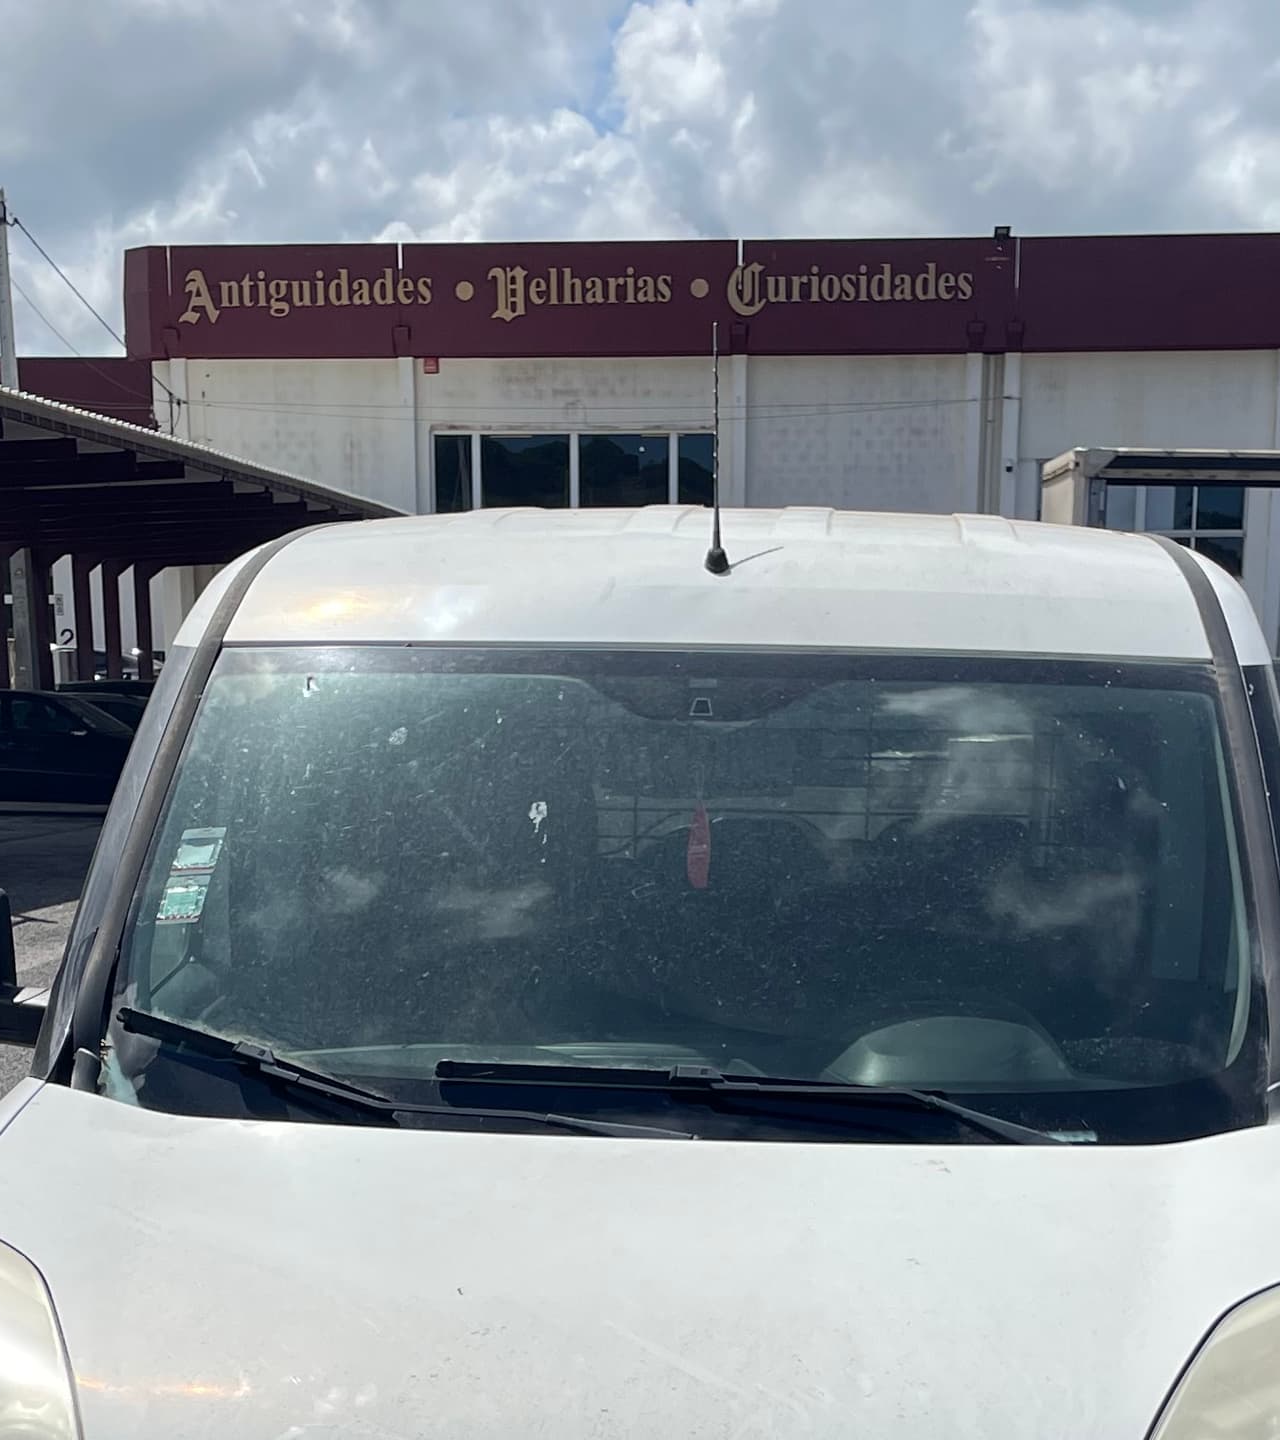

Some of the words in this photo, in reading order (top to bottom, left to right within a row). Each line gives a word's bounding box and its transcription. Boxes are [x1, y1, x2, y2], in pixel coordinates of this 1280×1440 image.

[178, 268, 433, 325] Antiguidades
[486, 265, 673, 323] Velharias
[726, 261, 974, 317] Curiosidades
